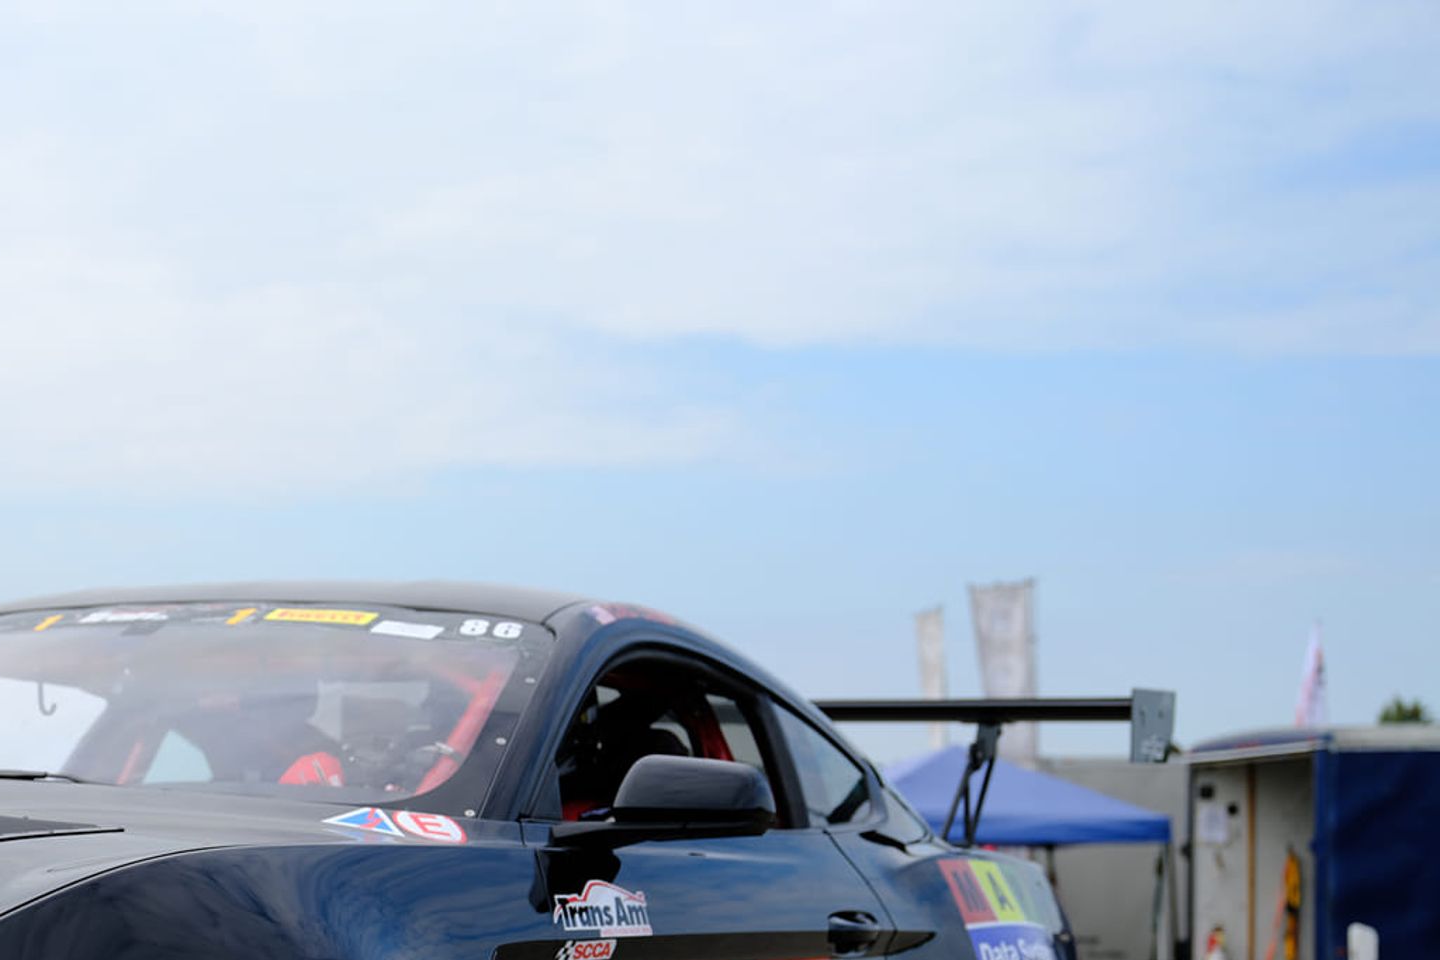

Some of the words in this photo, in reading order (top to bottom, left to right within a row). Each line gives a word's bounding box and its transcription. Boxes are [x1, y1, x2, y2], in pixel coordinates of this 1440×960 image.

[460, 619, 523, 639] 86
[557, 897, 614, 928] Trans
[615, 897, 648, 926] Am
[573, 942, 612, 960] SCCA
